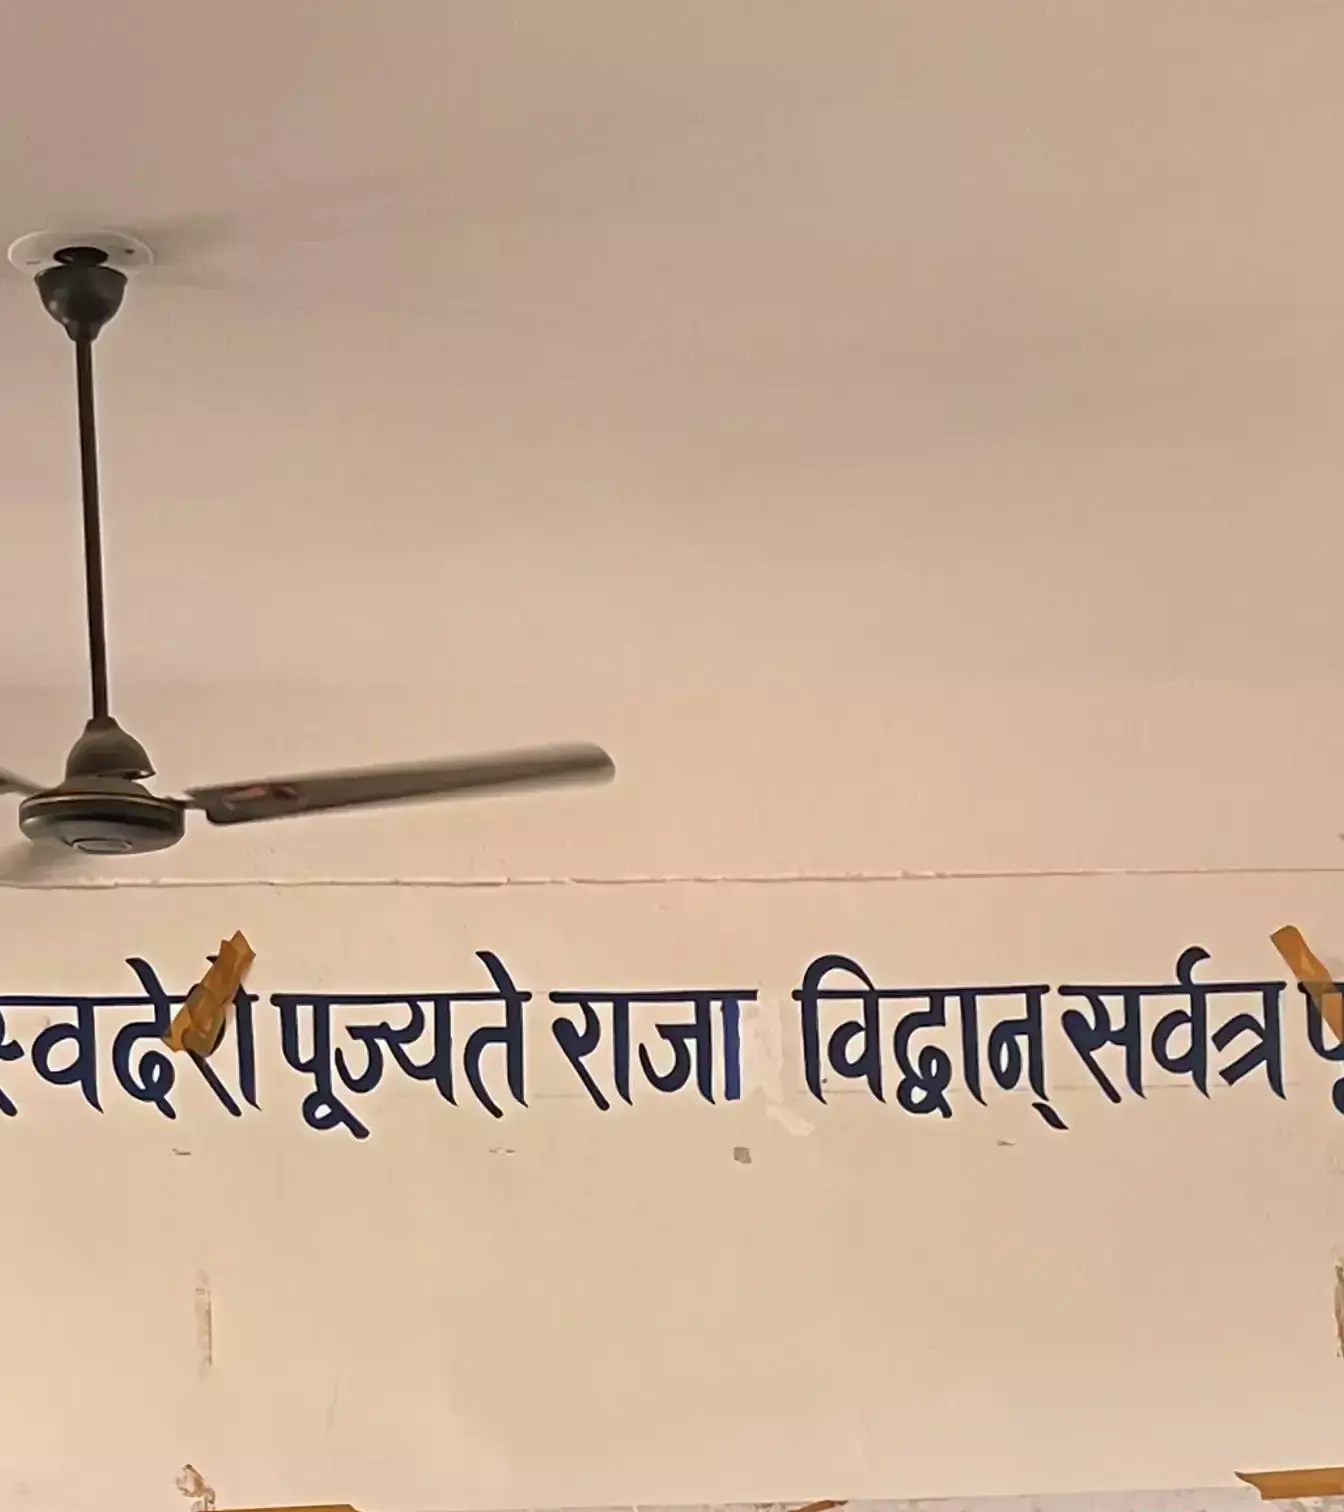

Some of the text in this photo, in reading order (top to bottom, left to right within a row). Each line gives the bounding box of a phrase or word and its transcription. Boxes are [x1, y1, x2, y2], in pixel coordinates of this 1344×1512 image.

[270, 951, 532, 1139] पूज्यते
[549, 988, 758, 1111] राजा
[792, 954, 1068, 1130] विद्वान्
[1058, 946, 1287, 1104] सर्वत्र
